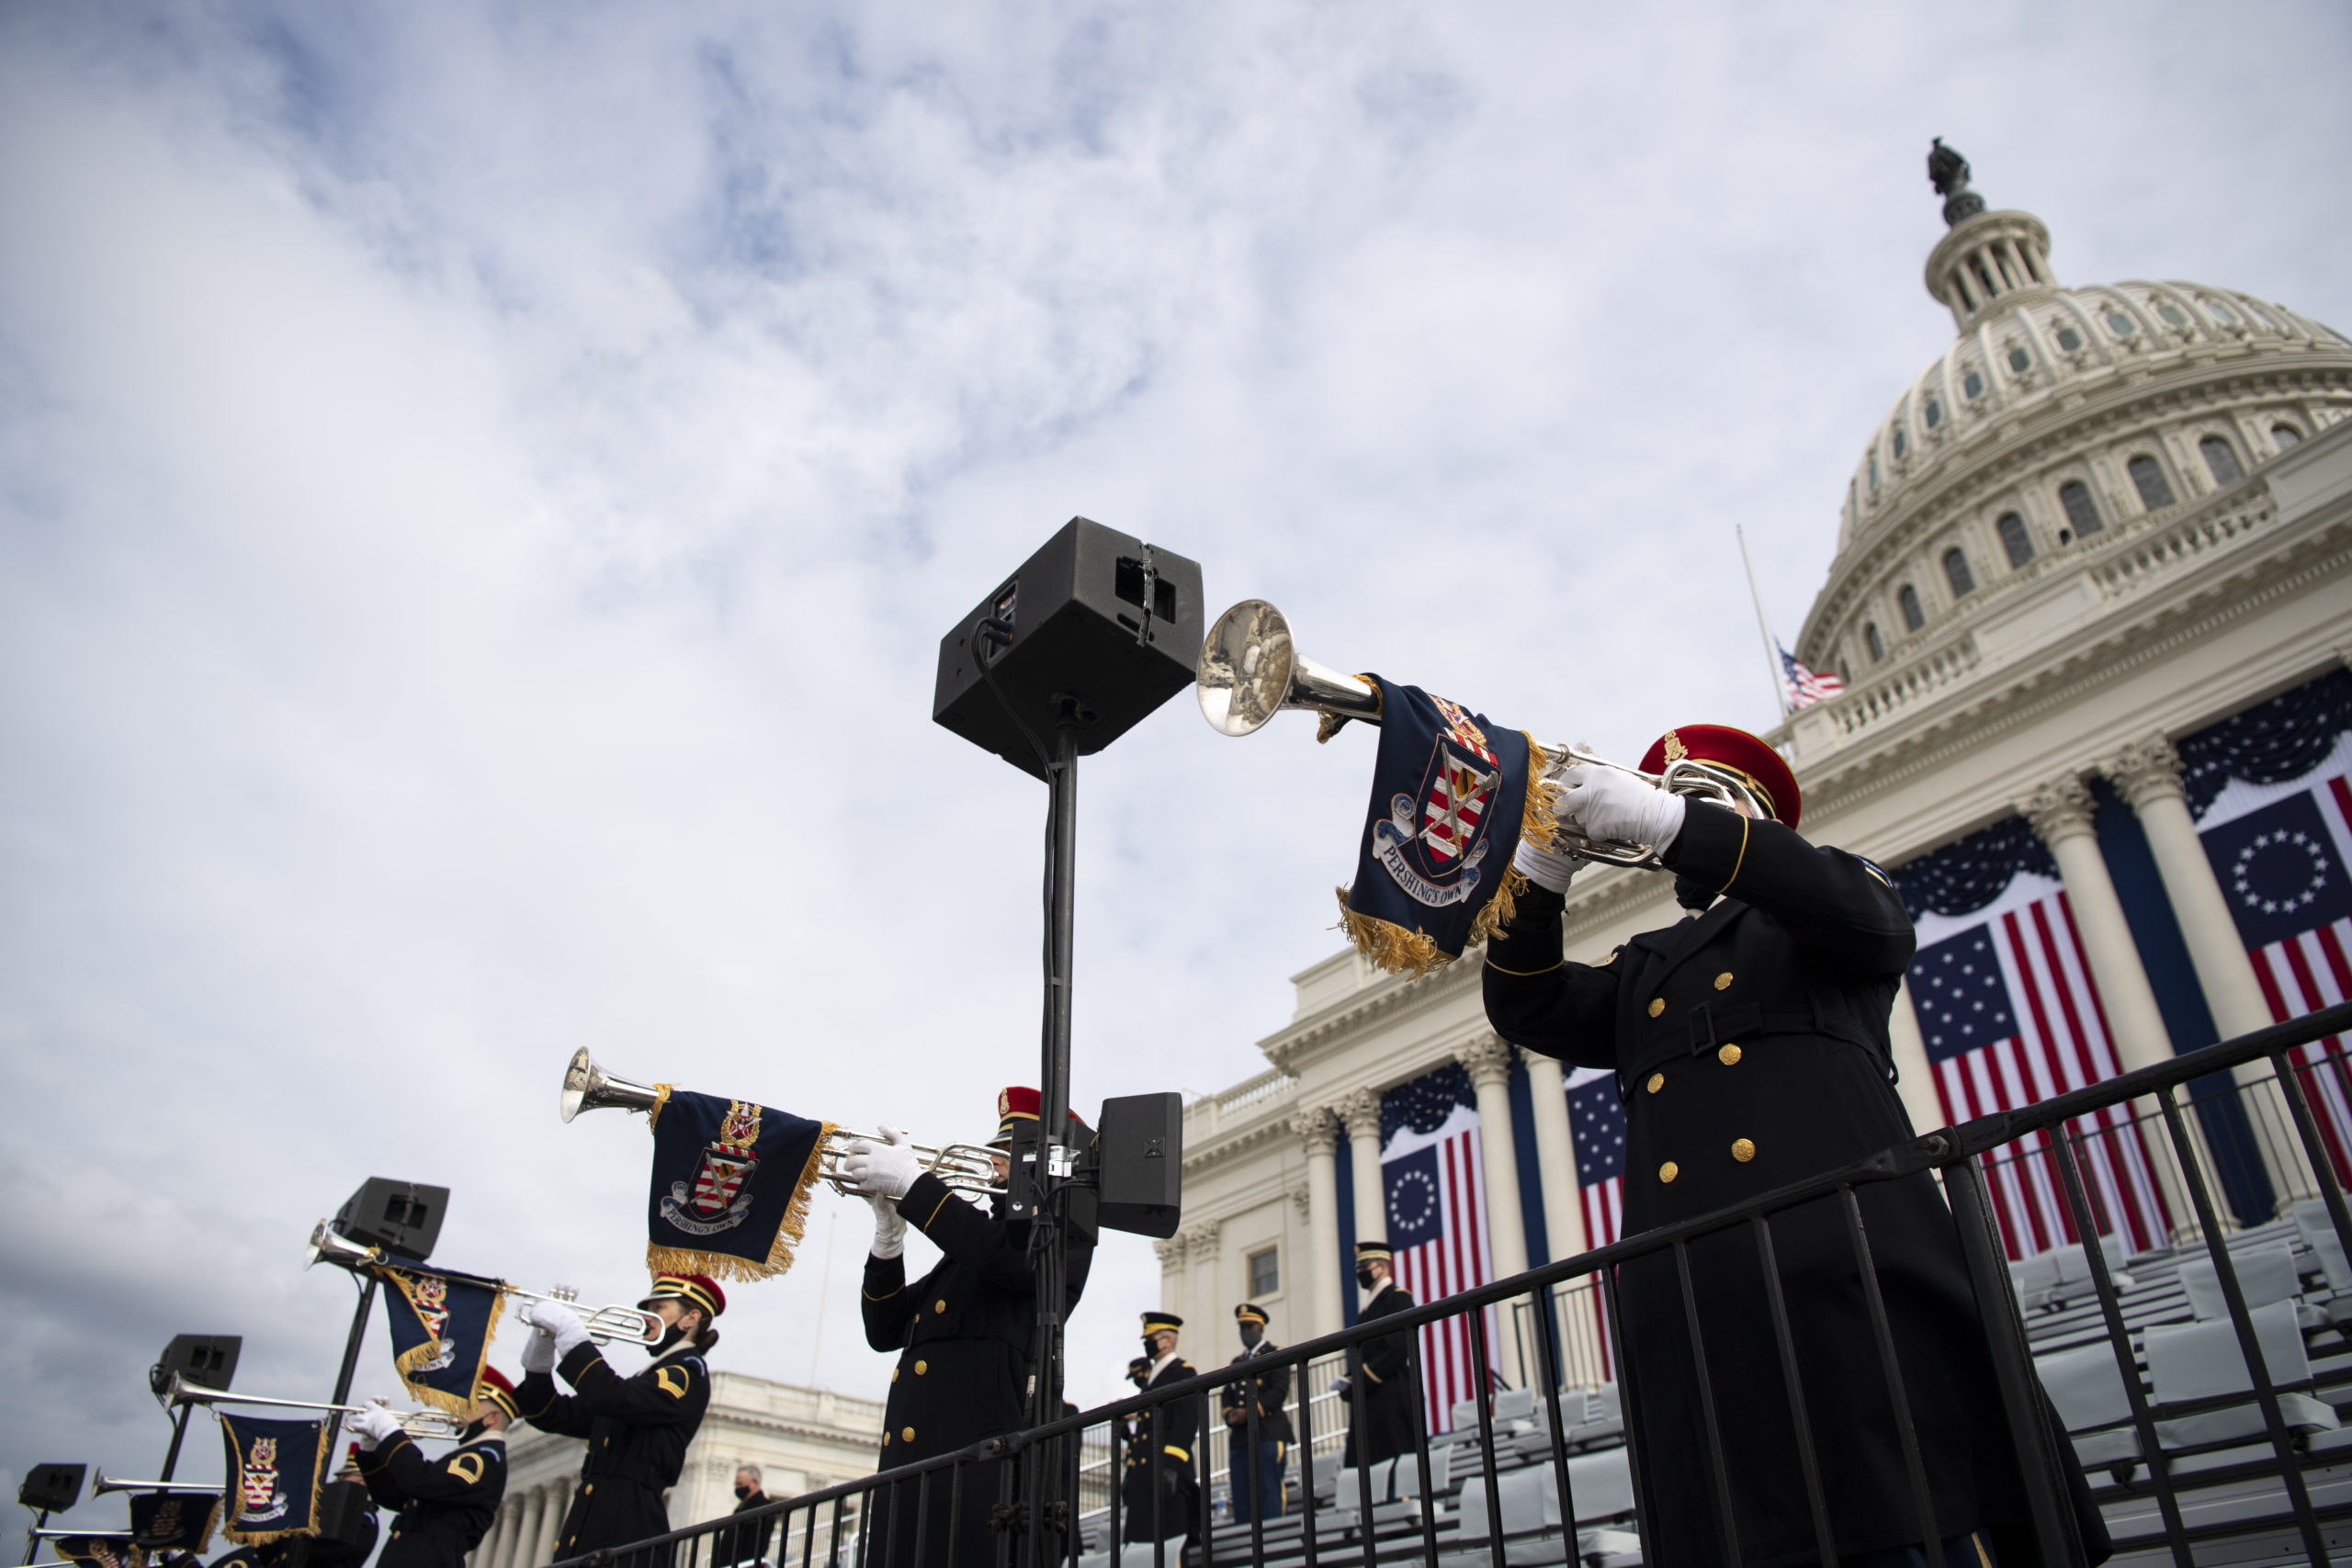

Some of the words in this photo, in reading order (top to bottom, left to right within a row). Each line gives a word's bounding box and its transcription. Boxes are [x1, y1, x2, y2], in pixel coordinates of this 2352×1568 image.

[1384, 845, 1440, 903] PERSHING'S
[1441, 884, 1461, 904] OWN
[668, 1208, 710, 1233] PERSHING'S
[712, 1219, 734, 1232] OWN
